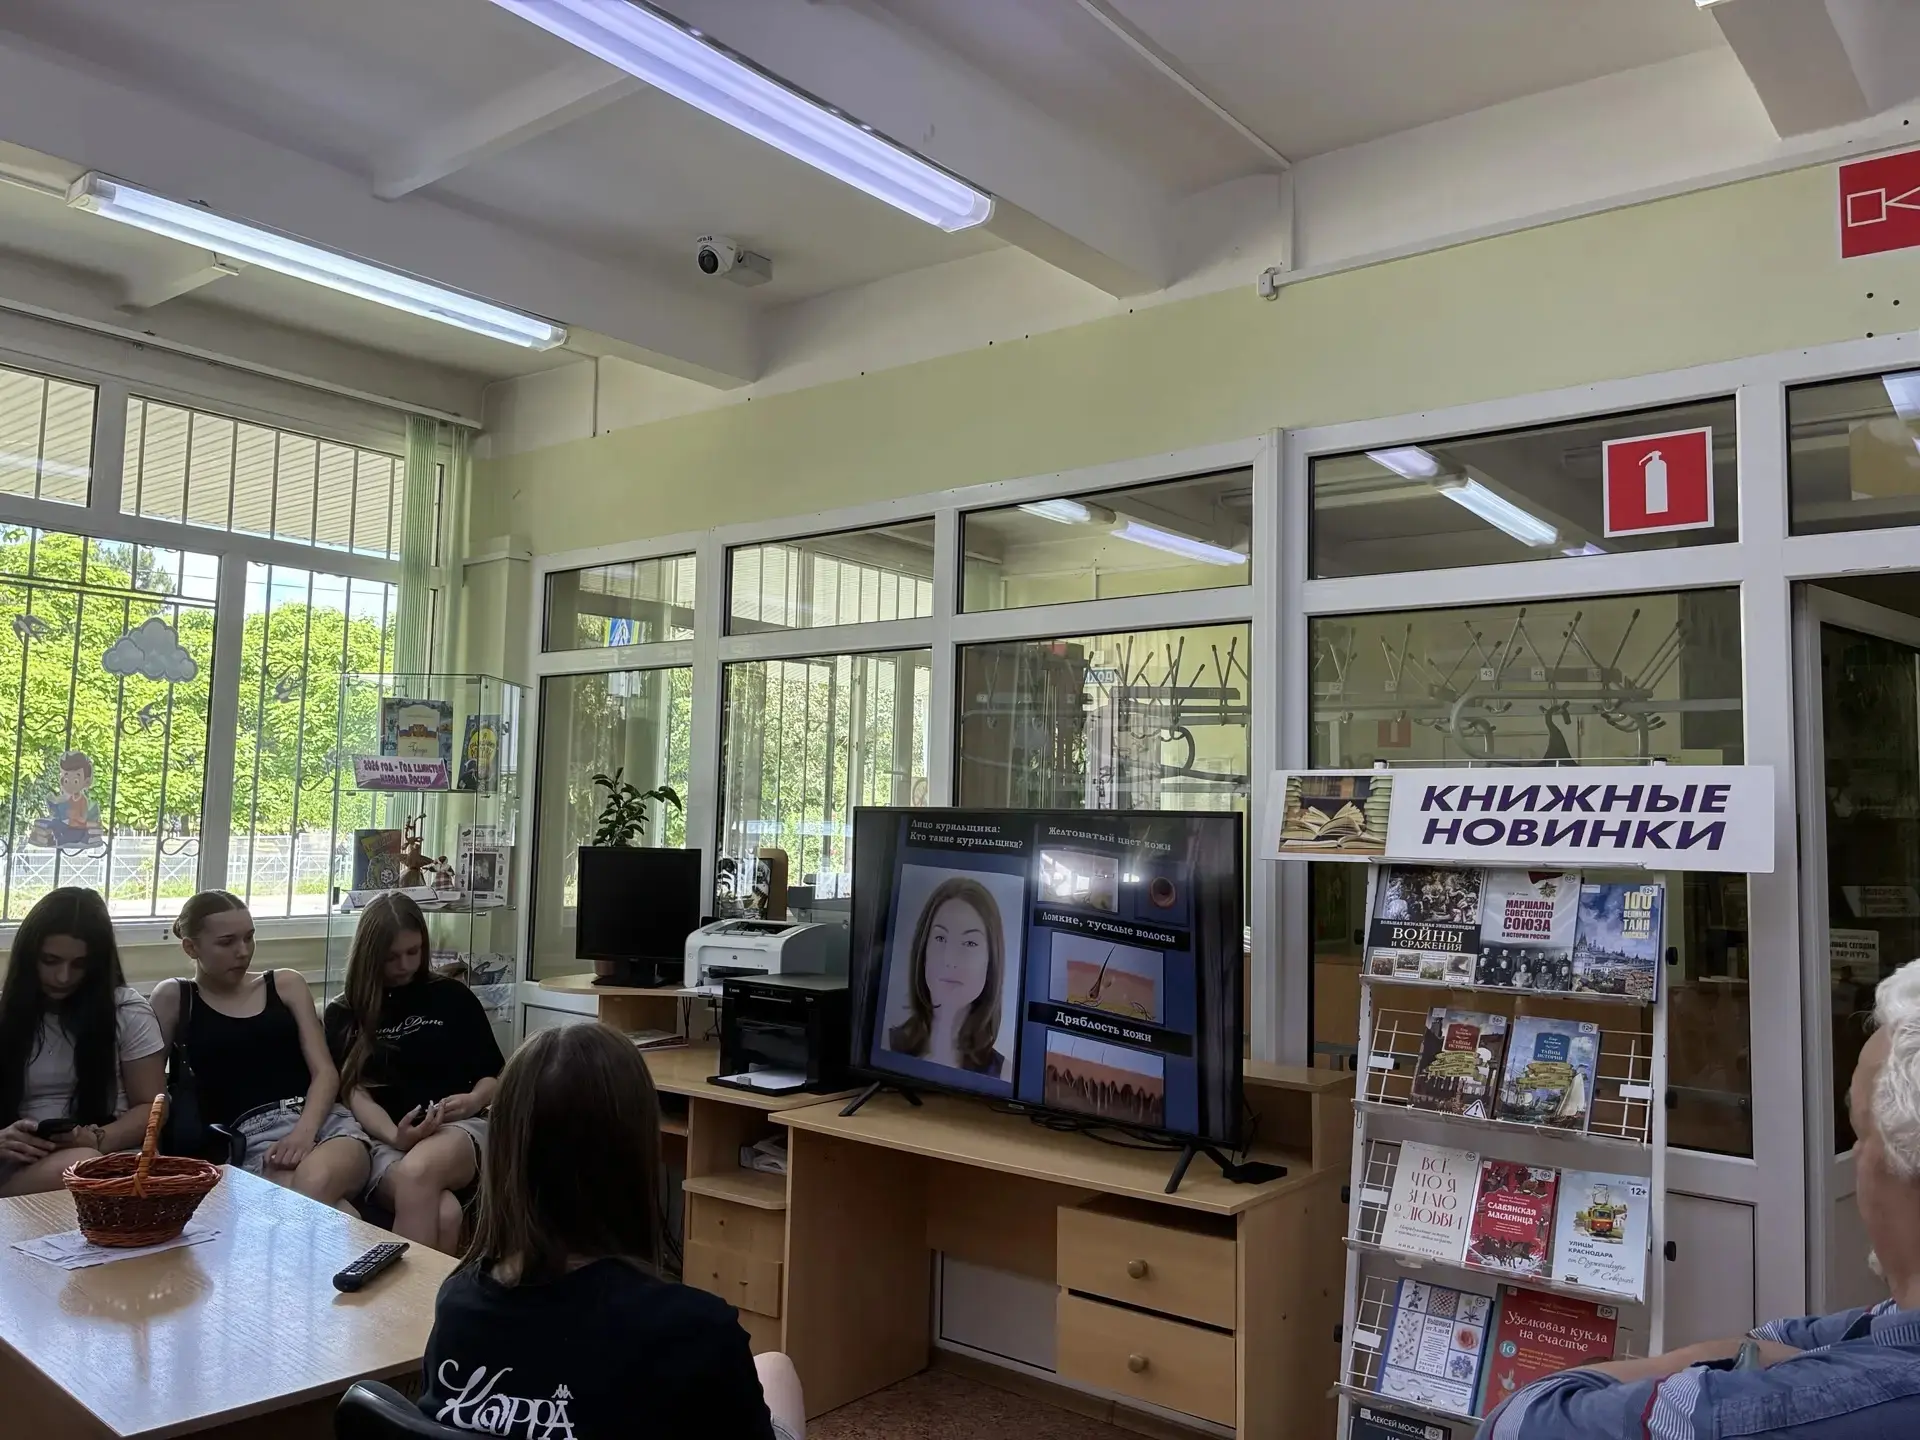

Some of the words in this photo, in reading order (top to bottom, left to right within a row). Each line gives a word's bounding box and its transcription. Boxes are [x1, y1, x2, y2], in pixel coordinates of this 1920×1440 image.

[363, 759, 379, 771] 2026
[1420, 784, 1731, 813] КНИЖНЫЕ
[911, 819, 933, 829] Лицо
[936, 823, 1001, 833] курильщика:
[1422, 818, 1726, 851] НОВИНКИ
[910, 831, 926, 841] Кто
[929, 835, 954, 843] такие
[956, 838, 1023, 849] курильщики?
[1048, 826, 1115, 843] Желтоватый
[1118, 836, 1141, 847] цвет
[1144, 841, 1172, 851] кожи
[1504, 908, 1553, 918] СОВЕТСКОГО
[1505, 899, 1555, 911] МАРШАЛЫ
[1042, 911, 1083, 927] Ломкие,
[1087, 919, 1133, 935] тусклые
[1136, 930, 1176, 943] волосы
[1503, 916, 1551, 932] СОЮЗА
[1623, 917, 1650, 931] ТАЙН
[1391, 926, 1464, 944] ВОЙНЫ
[1400, 939, 1462, 952] СРАЖЕНИЯ
[1055, 1011, 1120, 1035] Дряблость
[1122, 1028, 1152, 1042] кожи
[1411, 1171, 1442, 1189] ЧТО
[1447, 1178, 1456, 1193] Я
[1408, 1189, 1457, 1210] ЗНАЮ
[1630, 1187, 1647, 1196] 12+
[1487, 1201, 1537, 1216] СЛАВЯНСКАЯ
[1403, 1206, 1462, 1230] ЛЮБВИ
[1487, 1210, 1534, 1226] МАСЛЕНИЦА
[1568, 1240, 1594, 1249] УЛИЦЫ
[1568, 1247, 1613, 1259] КРАСНОДАРА
[1504, 1310, 1566, 1334] Узелковая
[1570, 1327, 1608, 1343] кукла
[1519, 1329, 1533, 1340] на
[1537, 1333, 1588, 1352] счастье
